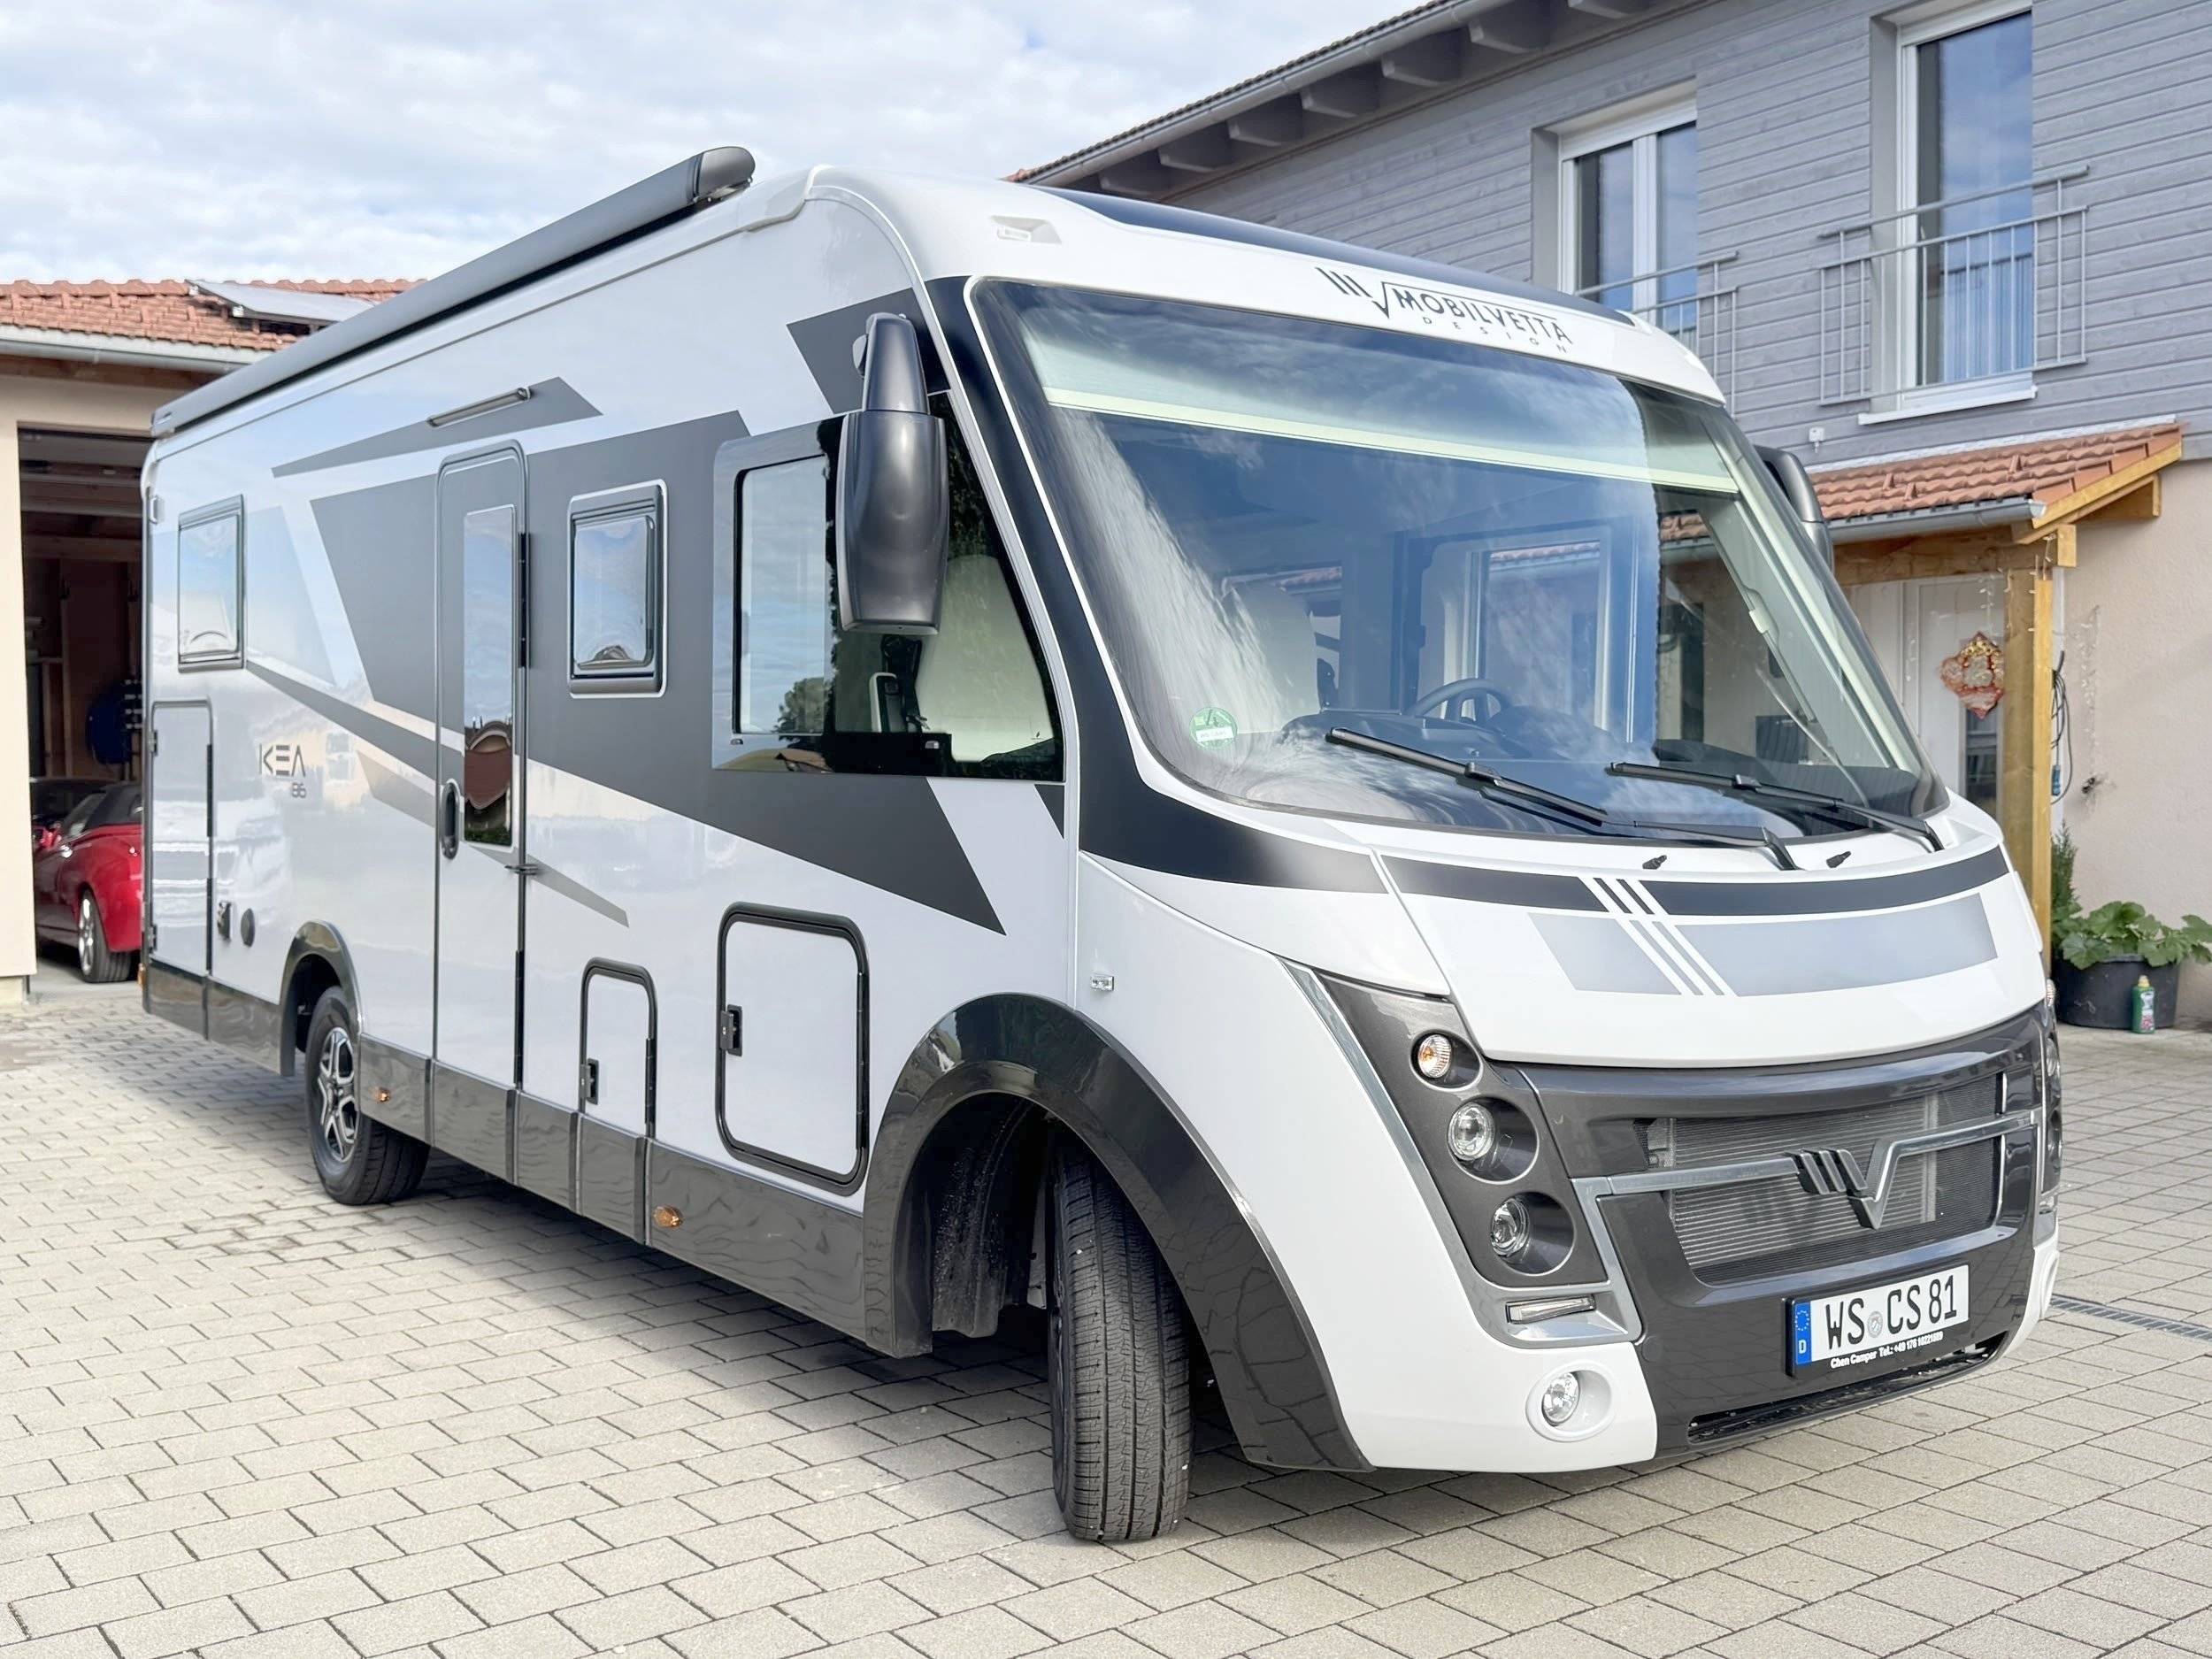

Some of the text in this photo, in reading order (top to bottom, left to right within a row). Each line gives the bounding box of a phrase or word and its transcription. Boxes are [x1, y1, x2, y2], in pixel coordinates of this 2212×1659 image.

[1392, 288, 1573, 345] MOBILVETTA
[1423, 316, 1568, 354] DESIGN
[259, 743, 306, 778] KEA
[1824, 1297, 1865, 1350] WS
[1798, 1339, 1807, 1355] D
